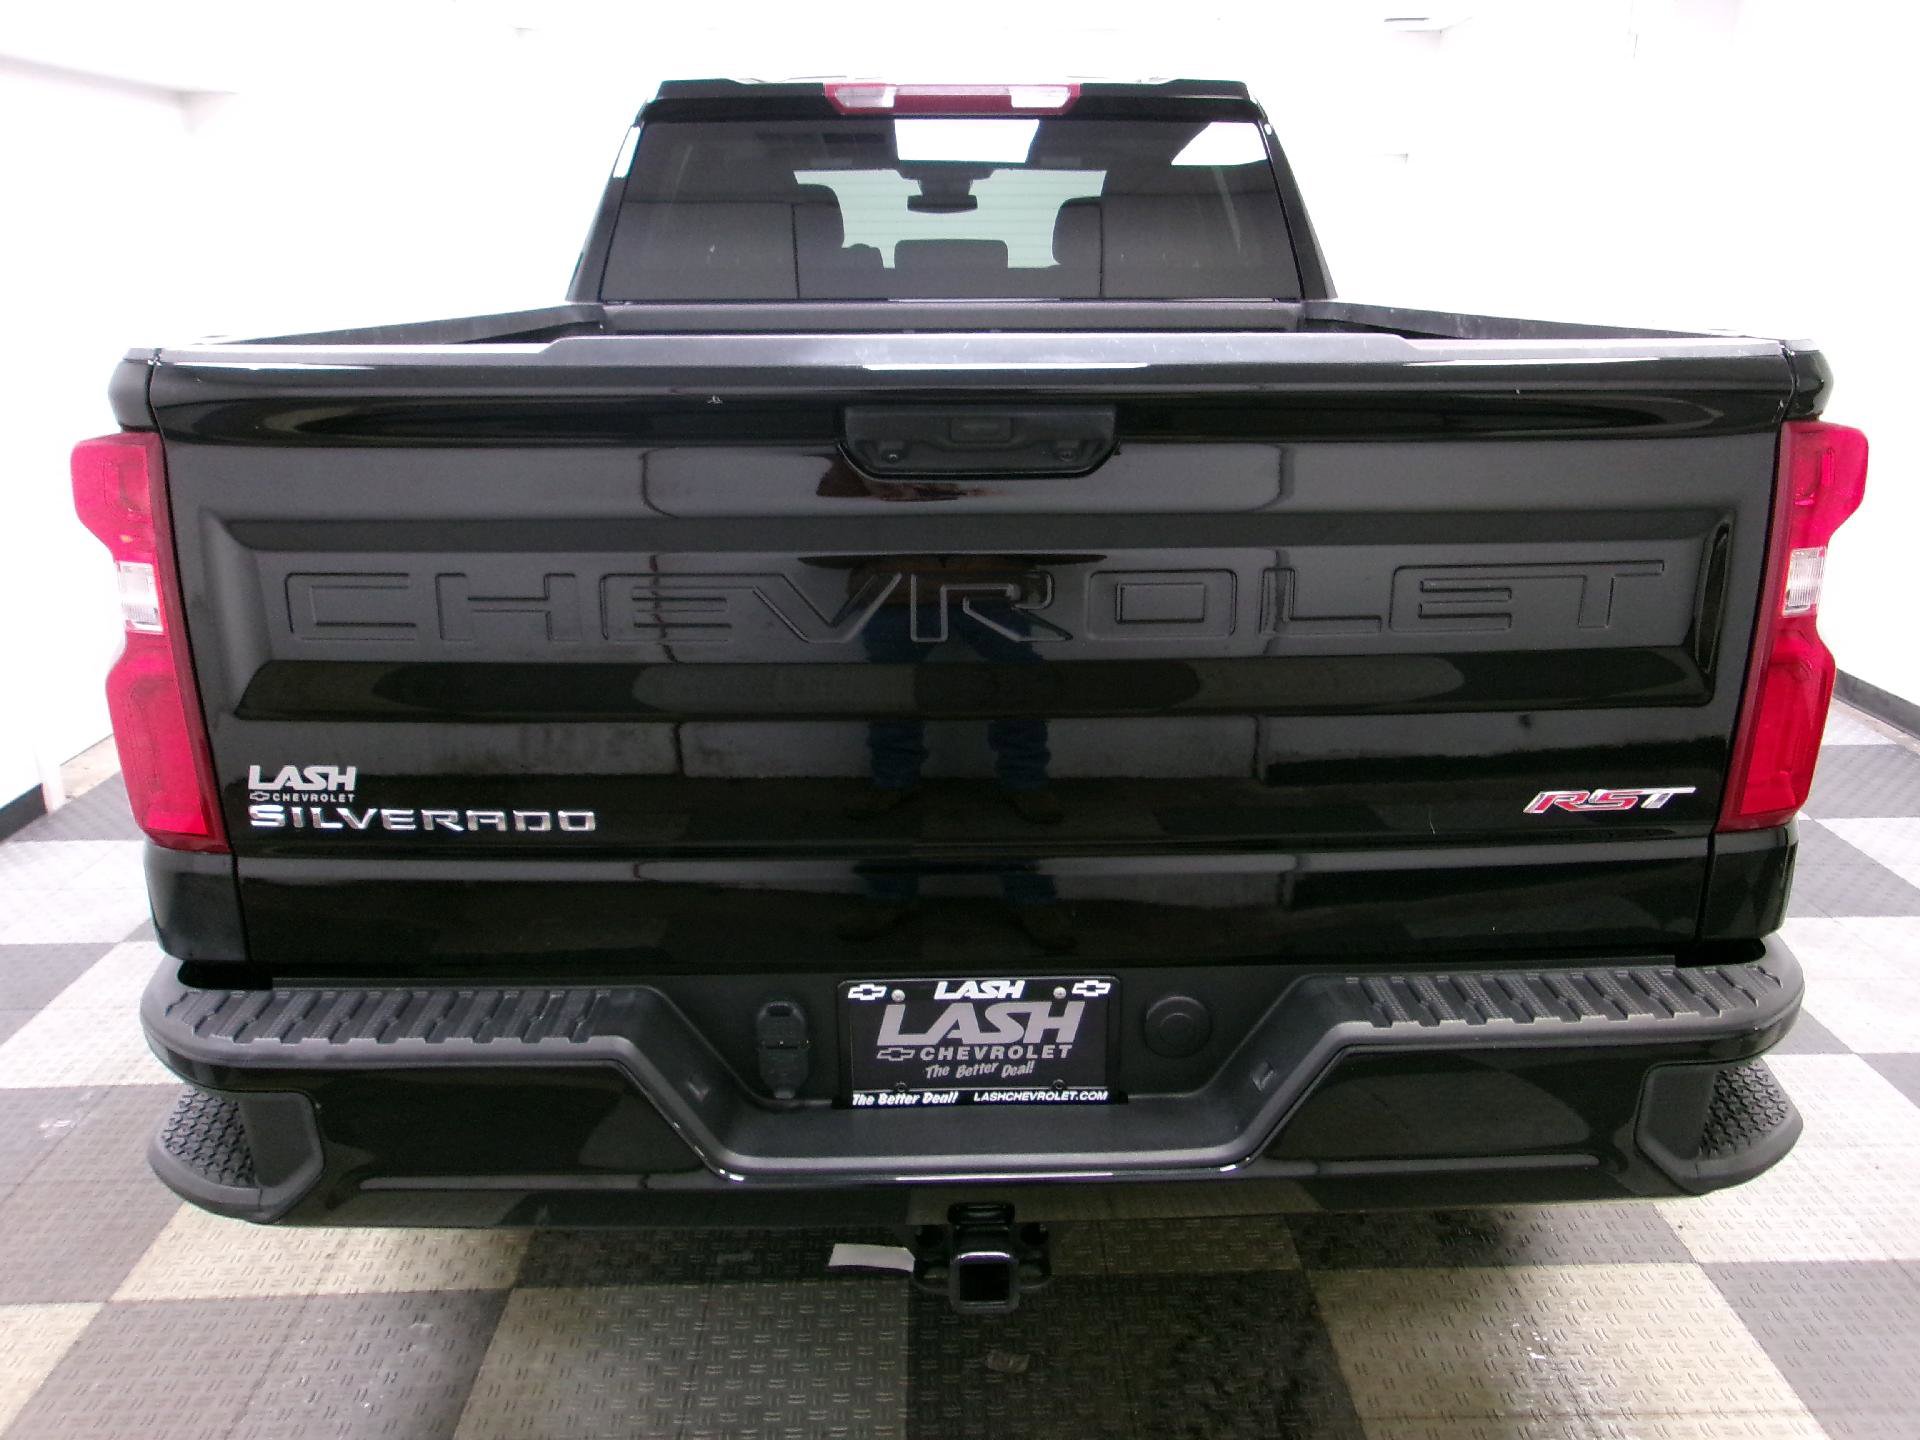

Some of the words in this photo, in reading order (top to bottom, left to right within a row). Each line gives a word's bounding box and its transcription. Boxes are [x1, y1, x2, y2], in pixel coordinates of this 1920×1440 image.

[284, 560, 1666, 645] CHEVROLET
[248, 765, 357, 791] LASH
[272, 793, 356, 802] CHEVROLET
[1523, 786, 1697, 814] RST
[248, 804, 596, 832] SILVERADO
[934, 980, 1026, 1000] LASH
[877, 1000, 1086, 1046] LASH
[919, 1044, 1073, 1061] CHEVROLET
[924, 1064, 950, 1079] The
[955, 1062, 999, 1079] Better
[852, 1093, 874, 1106] The
[877, 1093, 919, 1106] Better
[973, 1090, 1109, 1103] LASHCHEVROLET.COM
